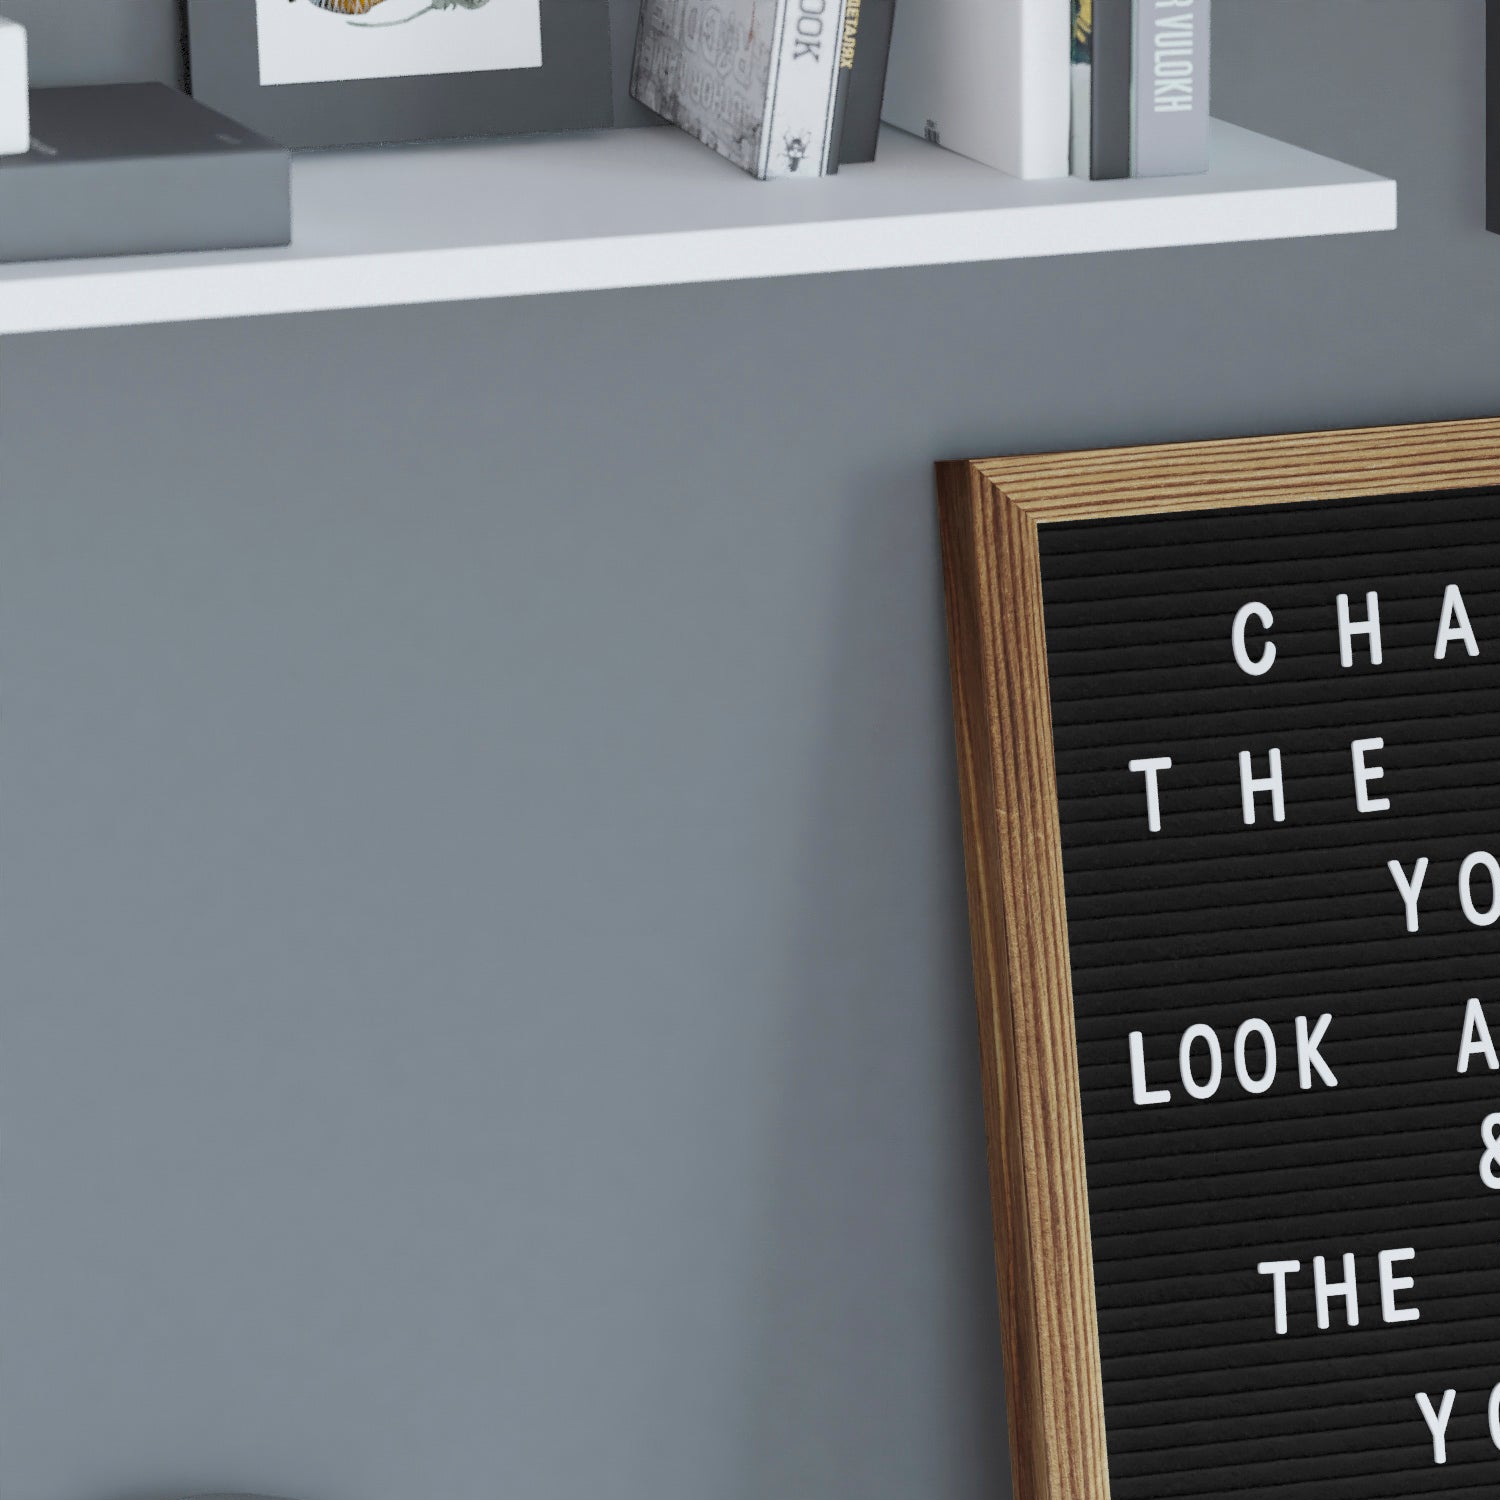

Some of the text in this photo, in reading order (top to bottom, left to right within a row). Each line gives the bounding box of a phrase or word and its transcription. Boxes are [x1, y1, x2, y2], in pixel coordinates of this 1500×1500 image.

[1153, 11, 1194, 114] VULOKH
[1127, 736, 1391, 833] THE
[1127, 1012, 1339, 1106] LOOK
[1256, 1247, 1421, 1335] THE
